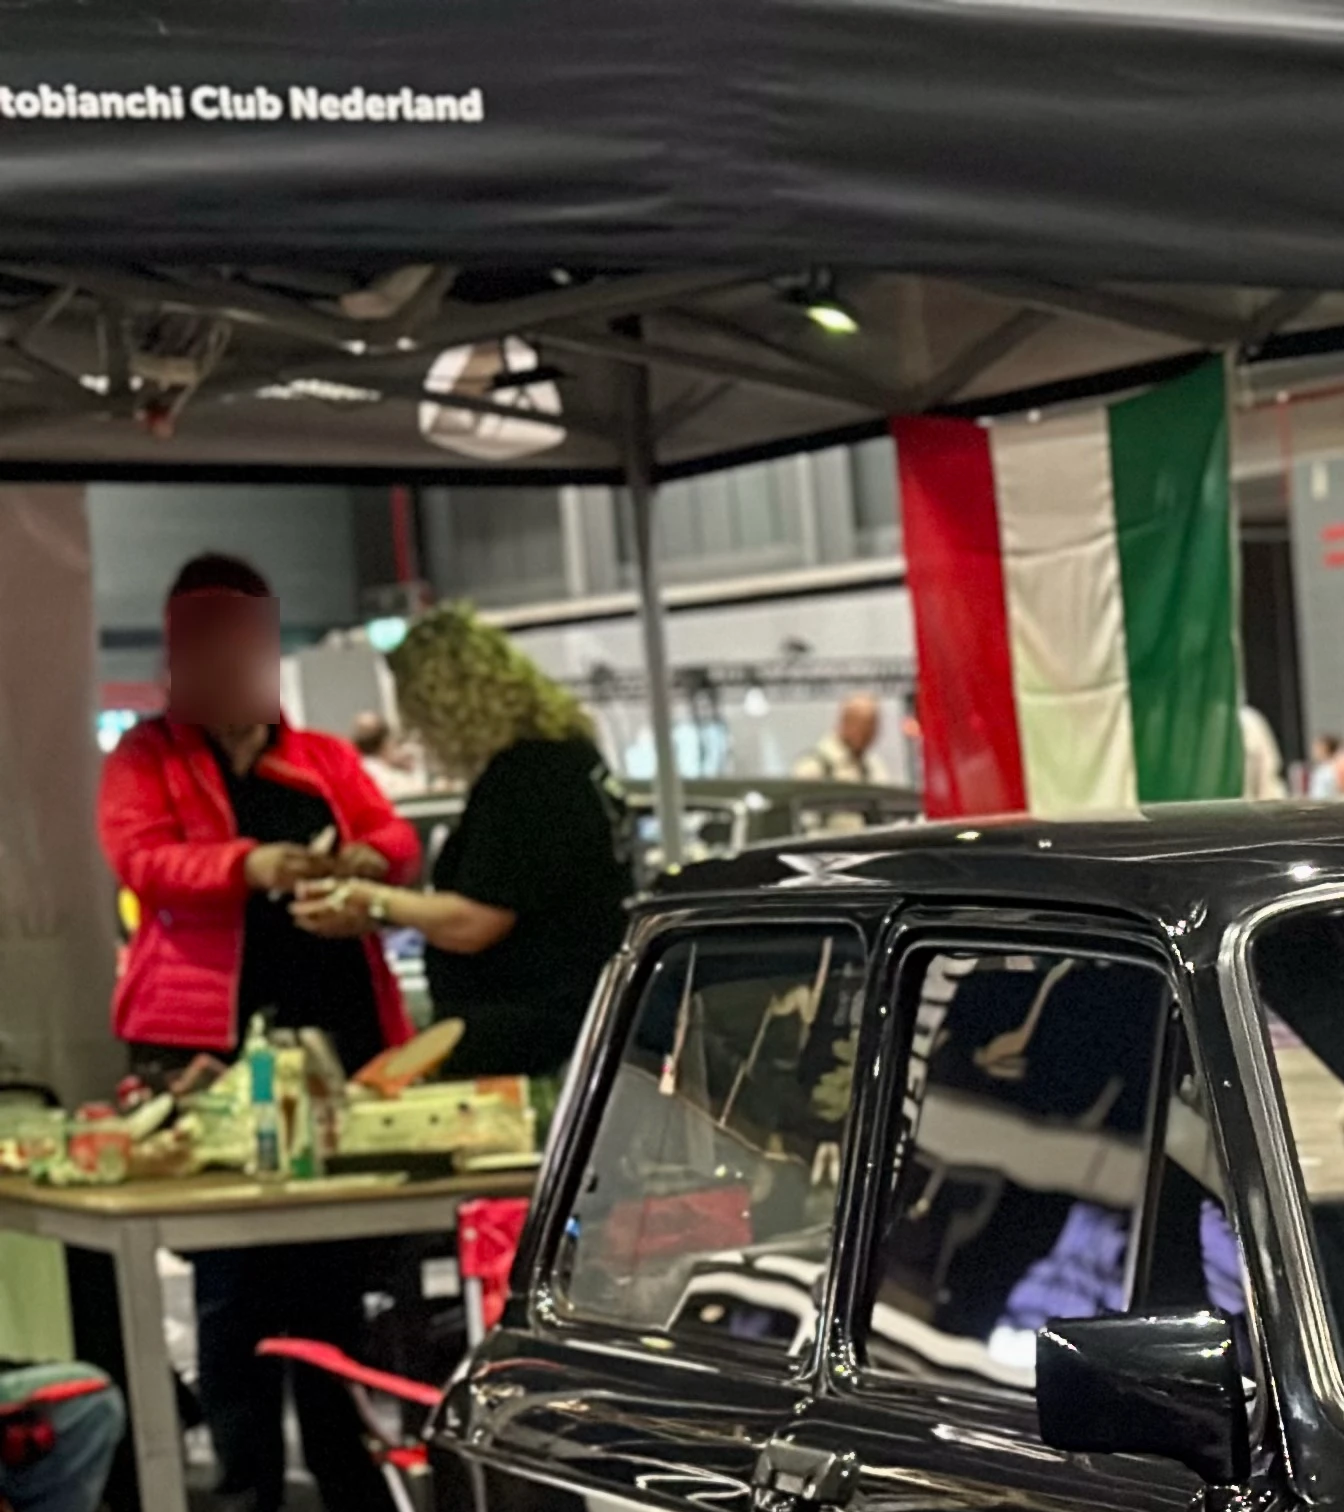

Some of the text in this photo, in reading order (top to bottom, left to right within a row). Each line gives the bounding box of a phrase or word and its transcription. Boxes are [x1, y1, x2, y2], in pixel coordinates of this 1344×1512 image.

[0, 84, 485, 122] tobianchi Club Nederland
